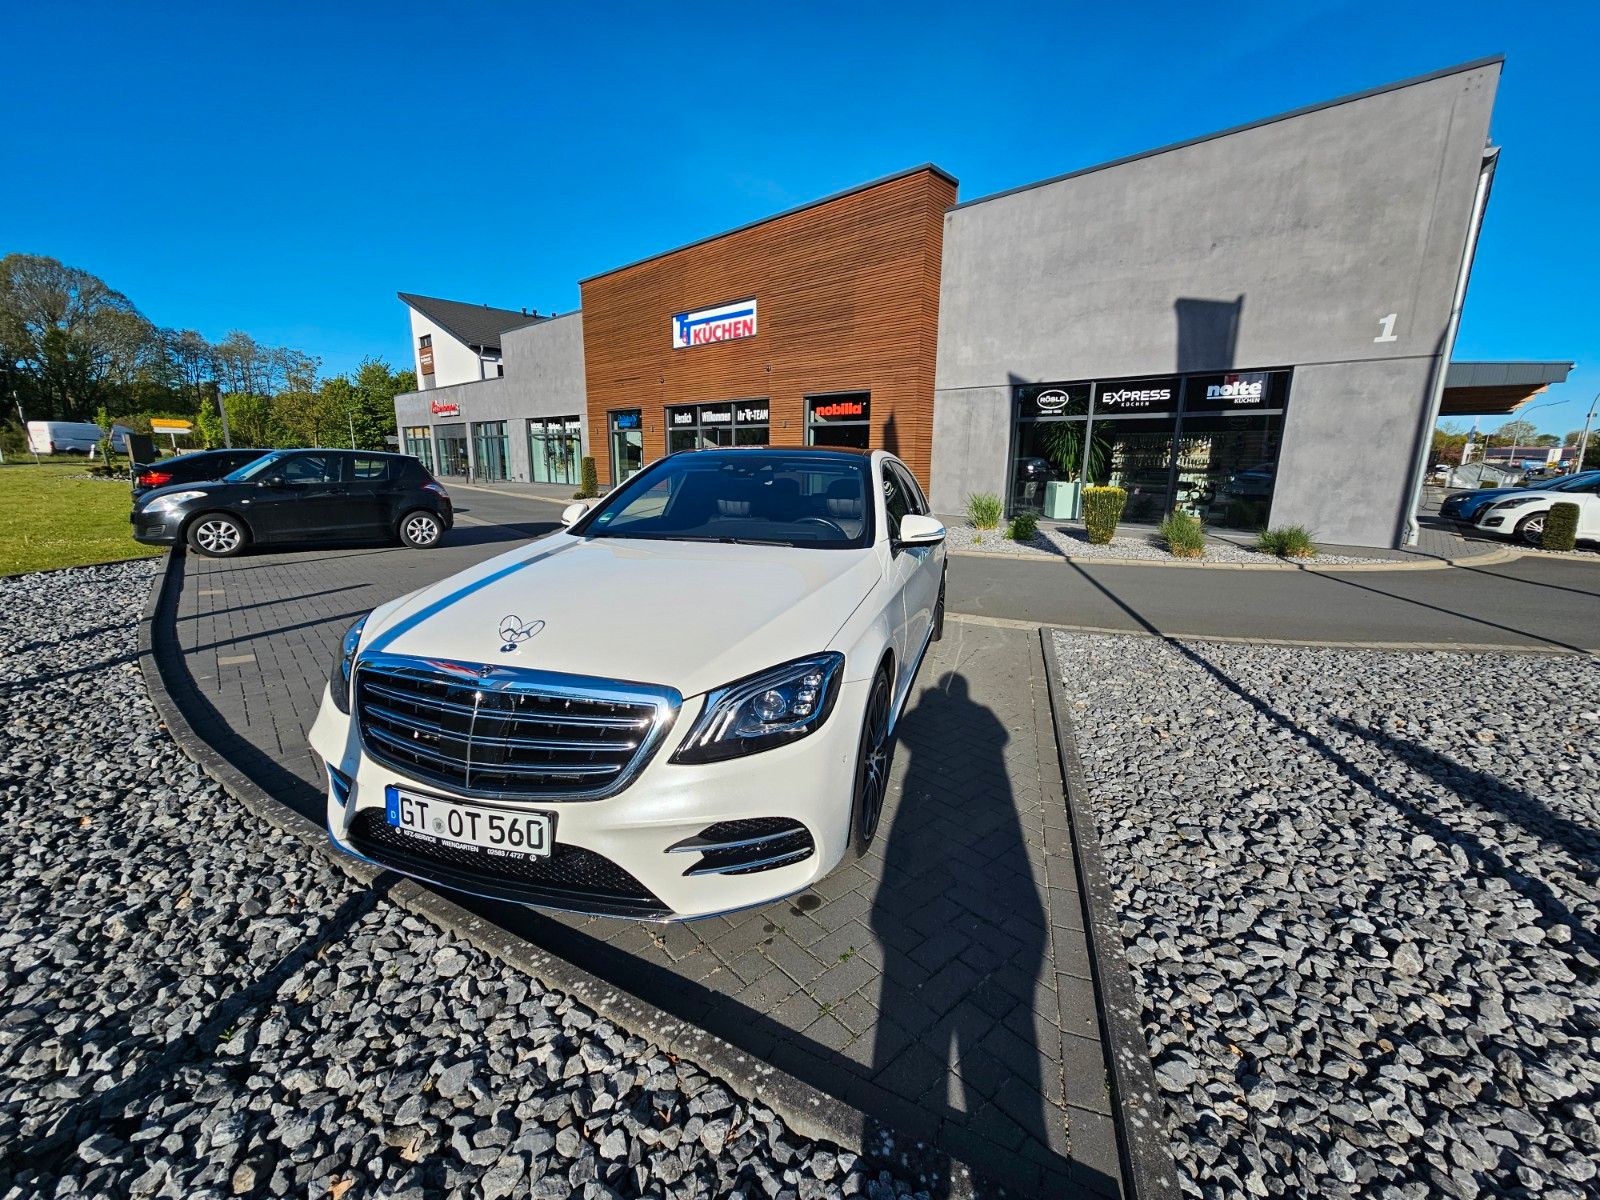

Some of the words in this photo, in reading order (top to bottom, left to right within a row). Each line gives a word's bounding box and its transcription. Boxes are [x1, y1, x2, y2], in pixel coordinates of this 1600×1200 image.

[693, 318, 753, 344] KÜCHEN
[1373, 313, 1398, 343] 1
[1102, 389, 1171, 405] EXPRESS
[1207, 381, 1262, 397] nolte
[675, 412, 692, 423] Herzlich
[702, 411, 731, 422] Willkommen
[391, 810, 396, 819] D
[400, 797, 429, 829] GT
[448, 809, 481, 840] OT
[489, 815, 544, 849] 560
[441, 840, 479, 852] WIENGARTEN
